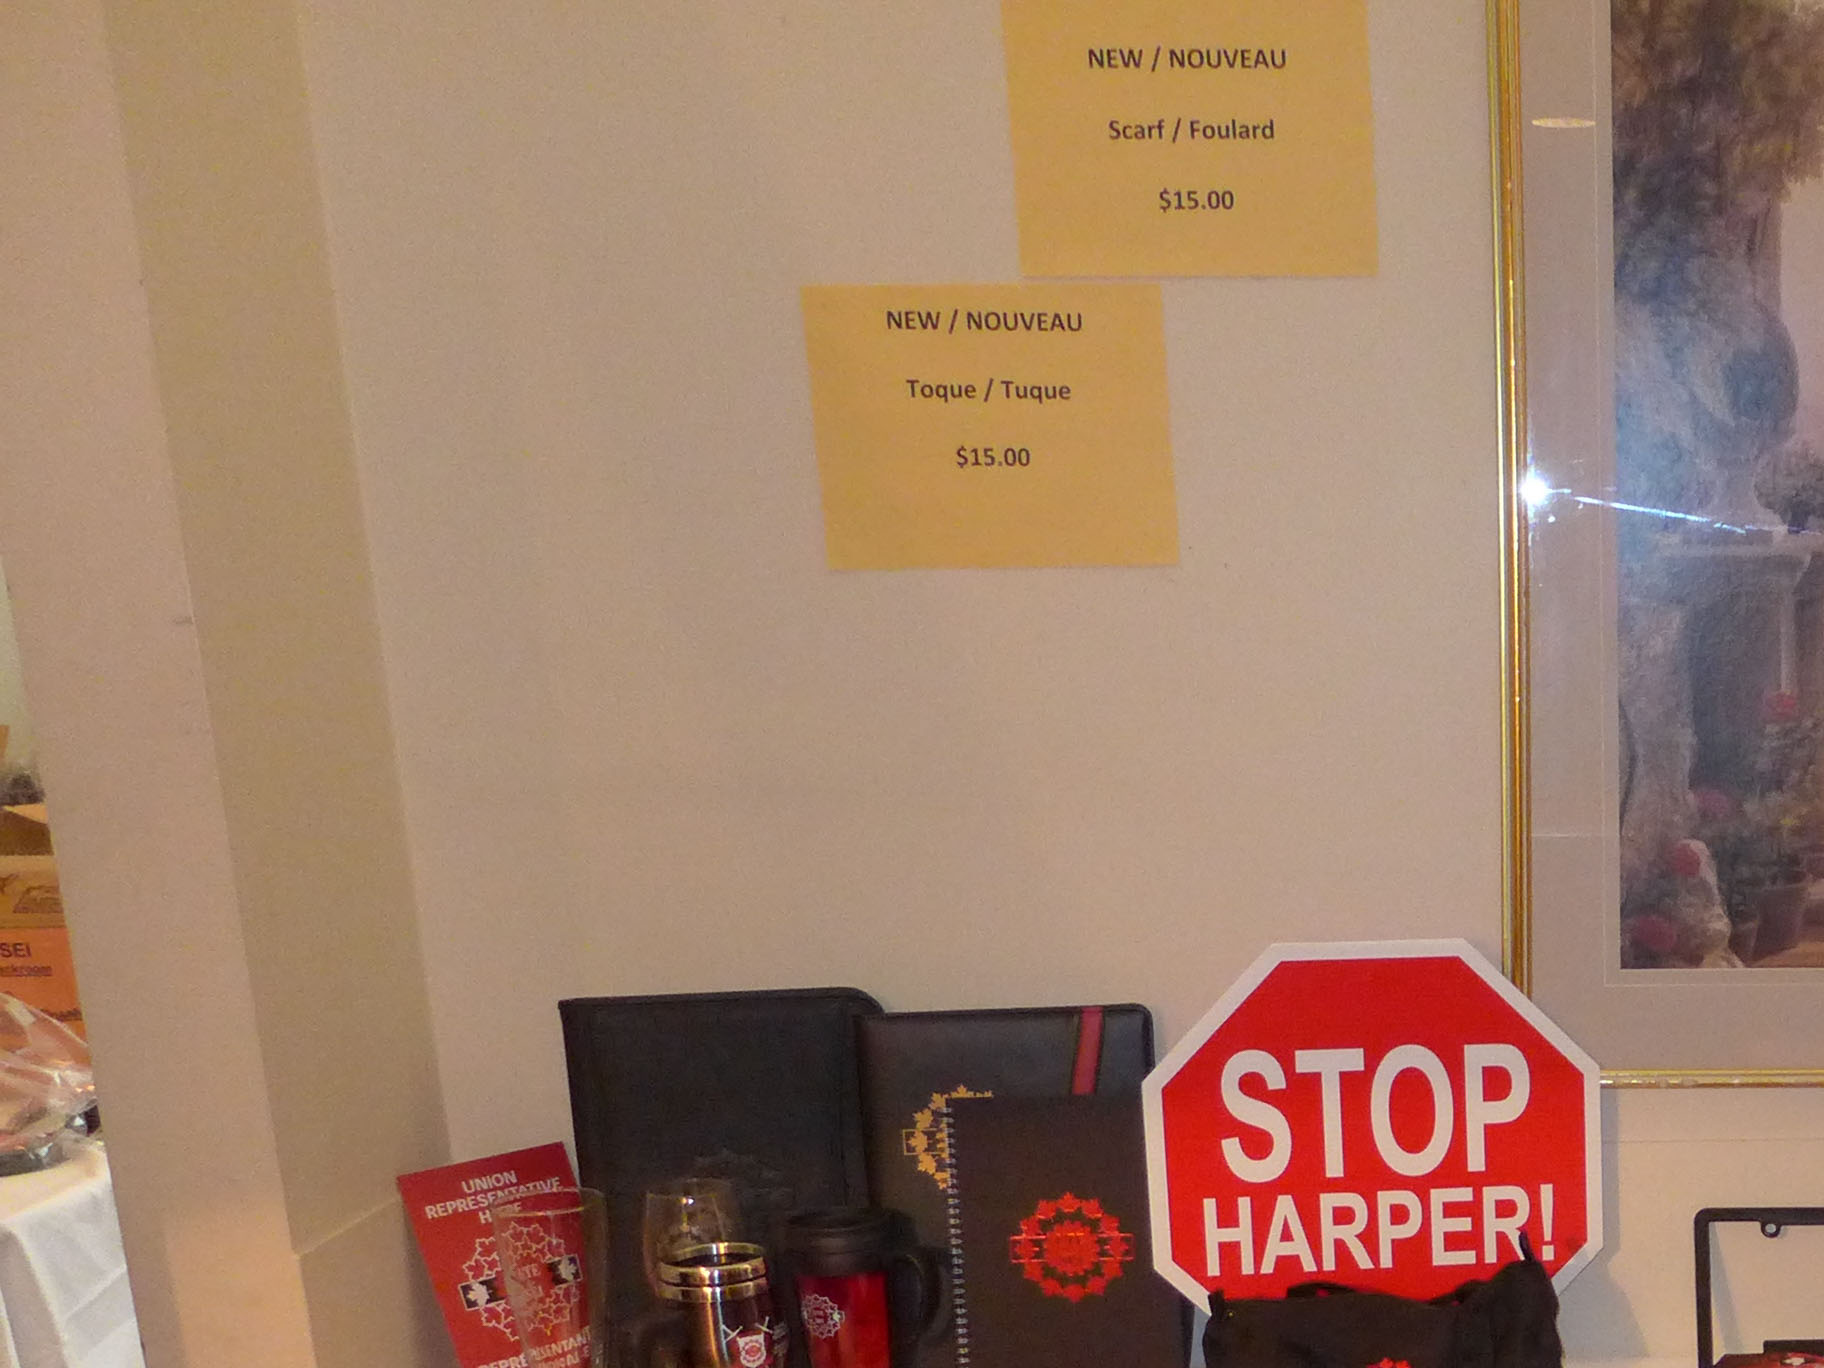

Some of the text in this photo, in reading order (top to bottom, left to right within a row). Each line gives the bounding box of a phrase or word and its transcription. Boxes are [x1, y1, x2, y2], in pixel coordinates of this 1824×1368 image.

[1088, 46, 1286, 72] NEW / NOUVEAU
[1109, 117, 1275, 144] Scarf / Foulard
[1159, 188, 1234, 213] $15.00
[886, 309, 1082, 334] NEW / NOUVEAU
[906, 378, 1071, 404] Toque / Tuque
[956, 445, 1030, 469] $15.00
[1220, 1043, 1531, 1184] STOP
[462, 1170, 518, 1194] UNION
[1202, 1183, 1555, 1278] HARPER!
